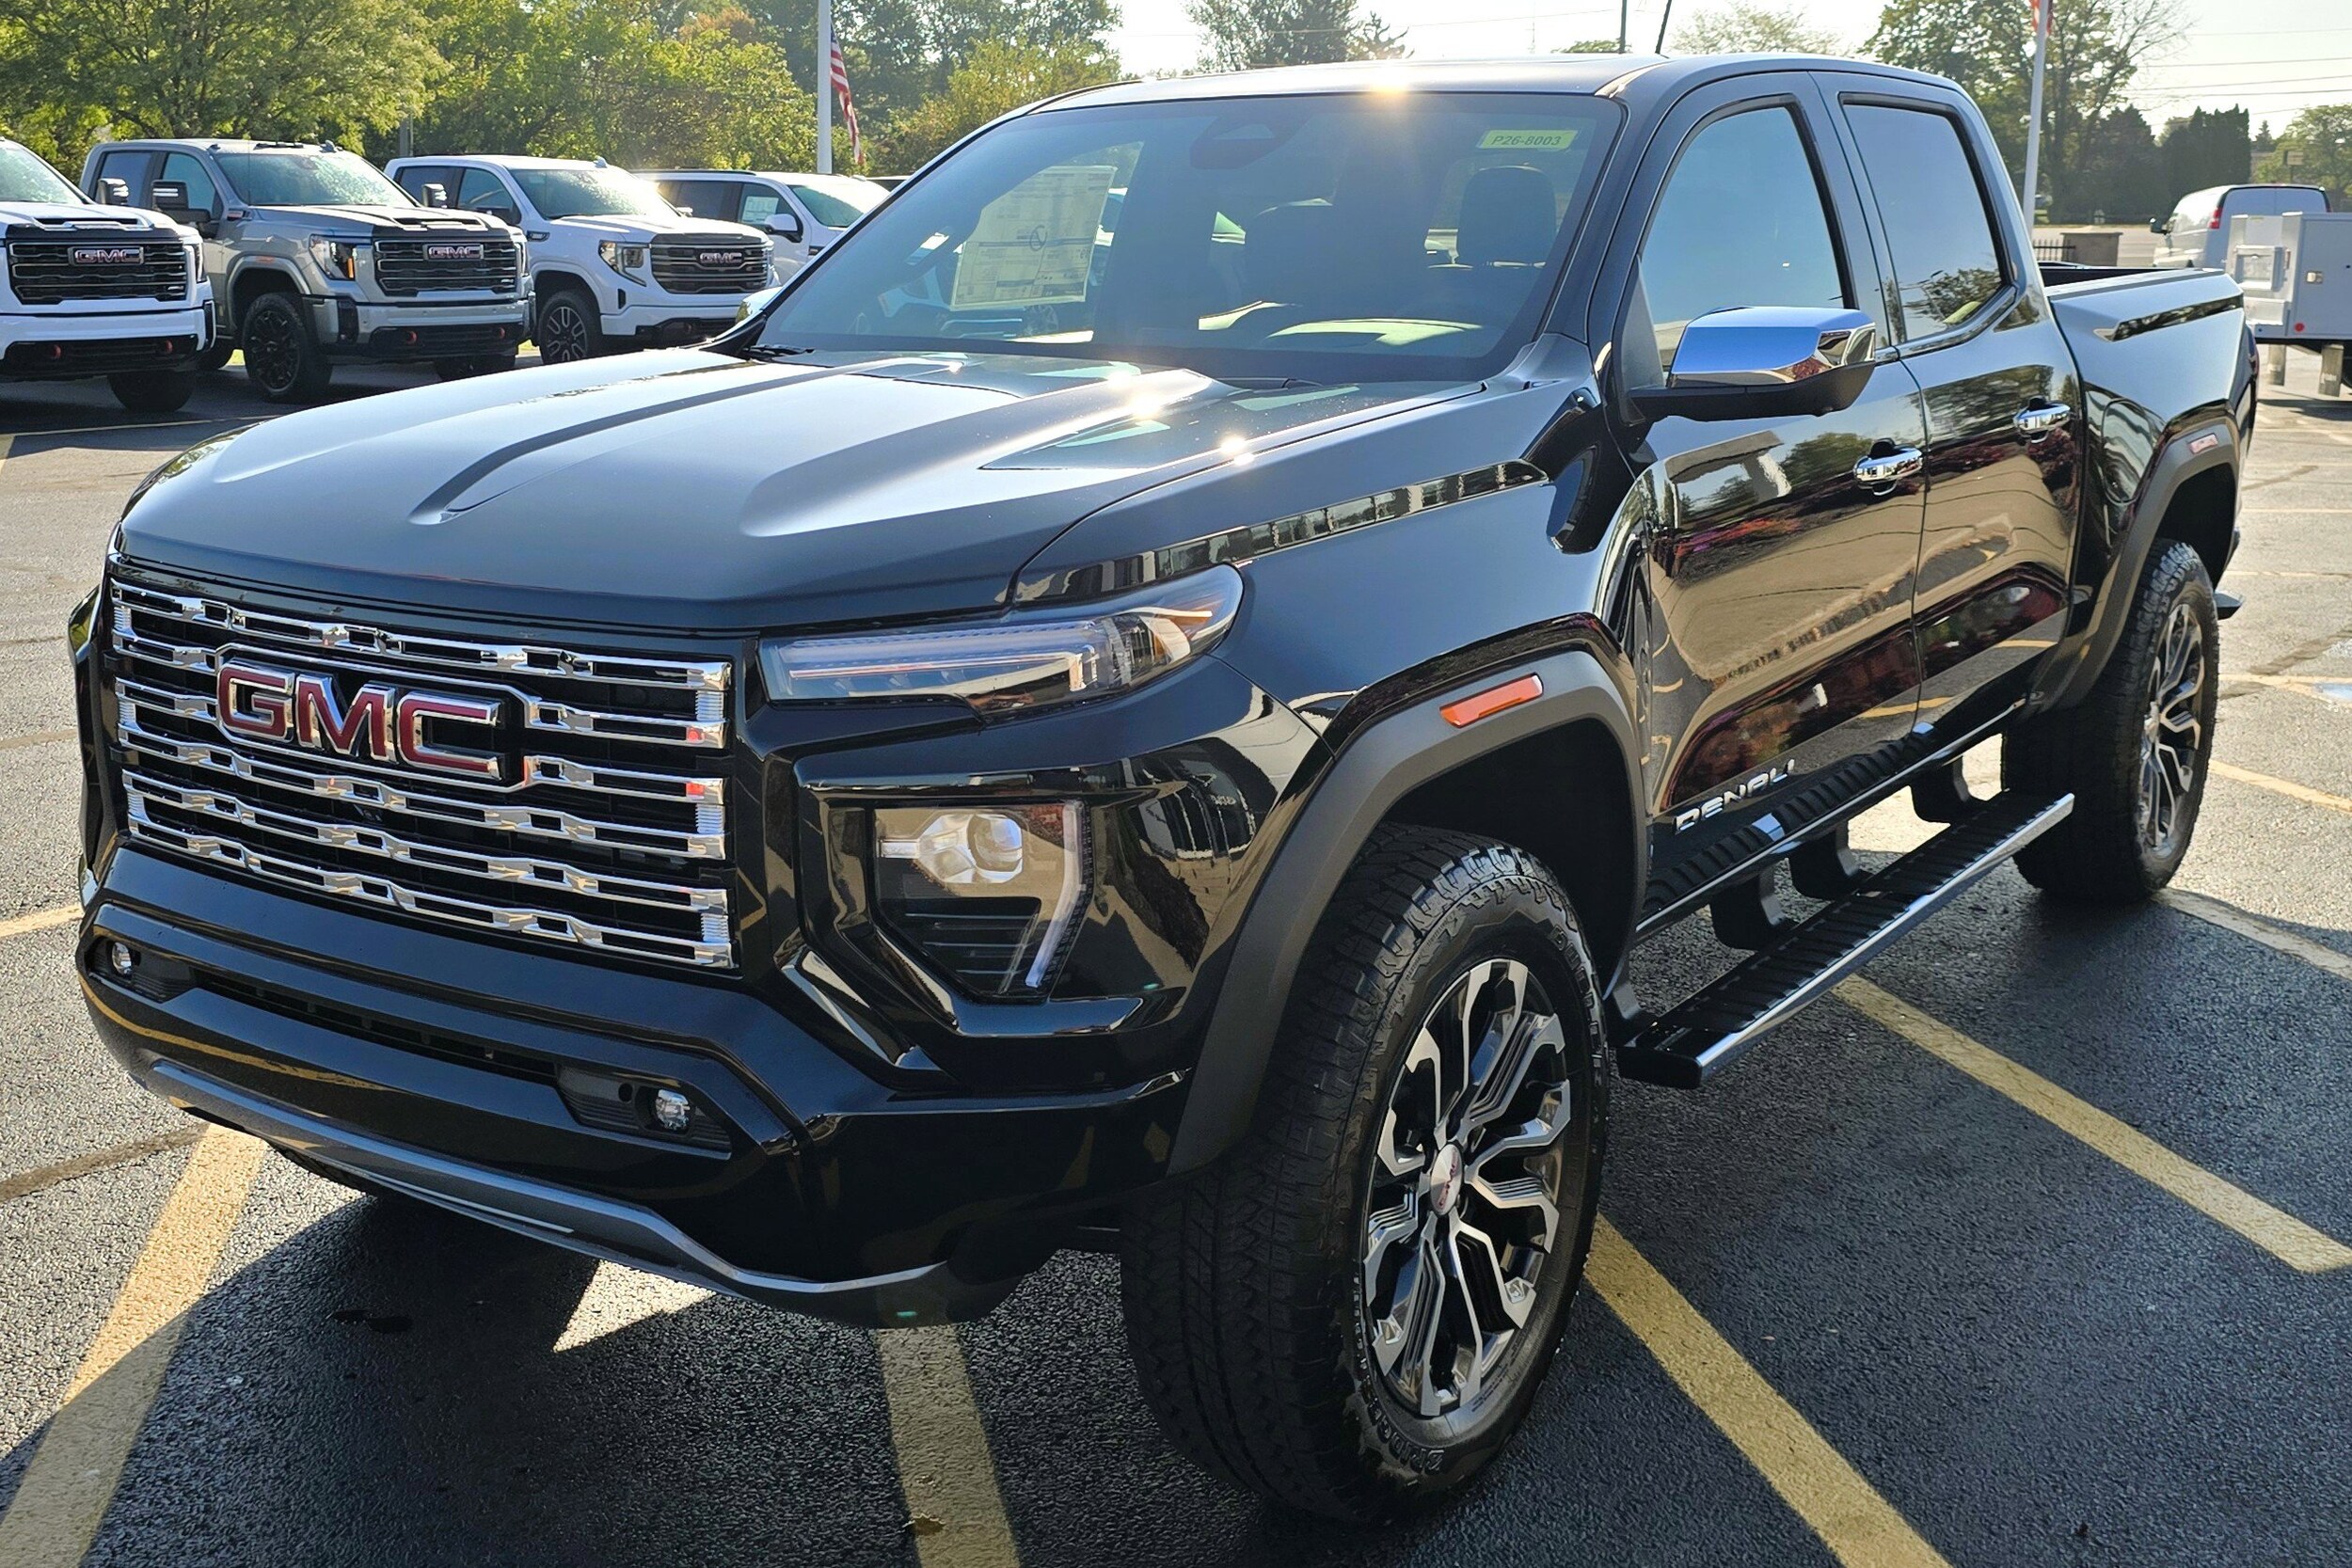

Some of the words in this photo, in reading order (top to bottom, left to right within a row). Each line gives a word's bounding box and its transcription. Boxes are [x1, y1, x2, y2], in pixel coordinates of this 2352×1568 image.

[1491, 135, 1562, 146] P26-8003
[74, 248, 141, 263] GMC
[428, 245, 482, 260] GMC
[699, 252, 742, 263] GMC
[216, 658, 502, 782] GMC
[1674, 758, 1795, 835] DENALI
